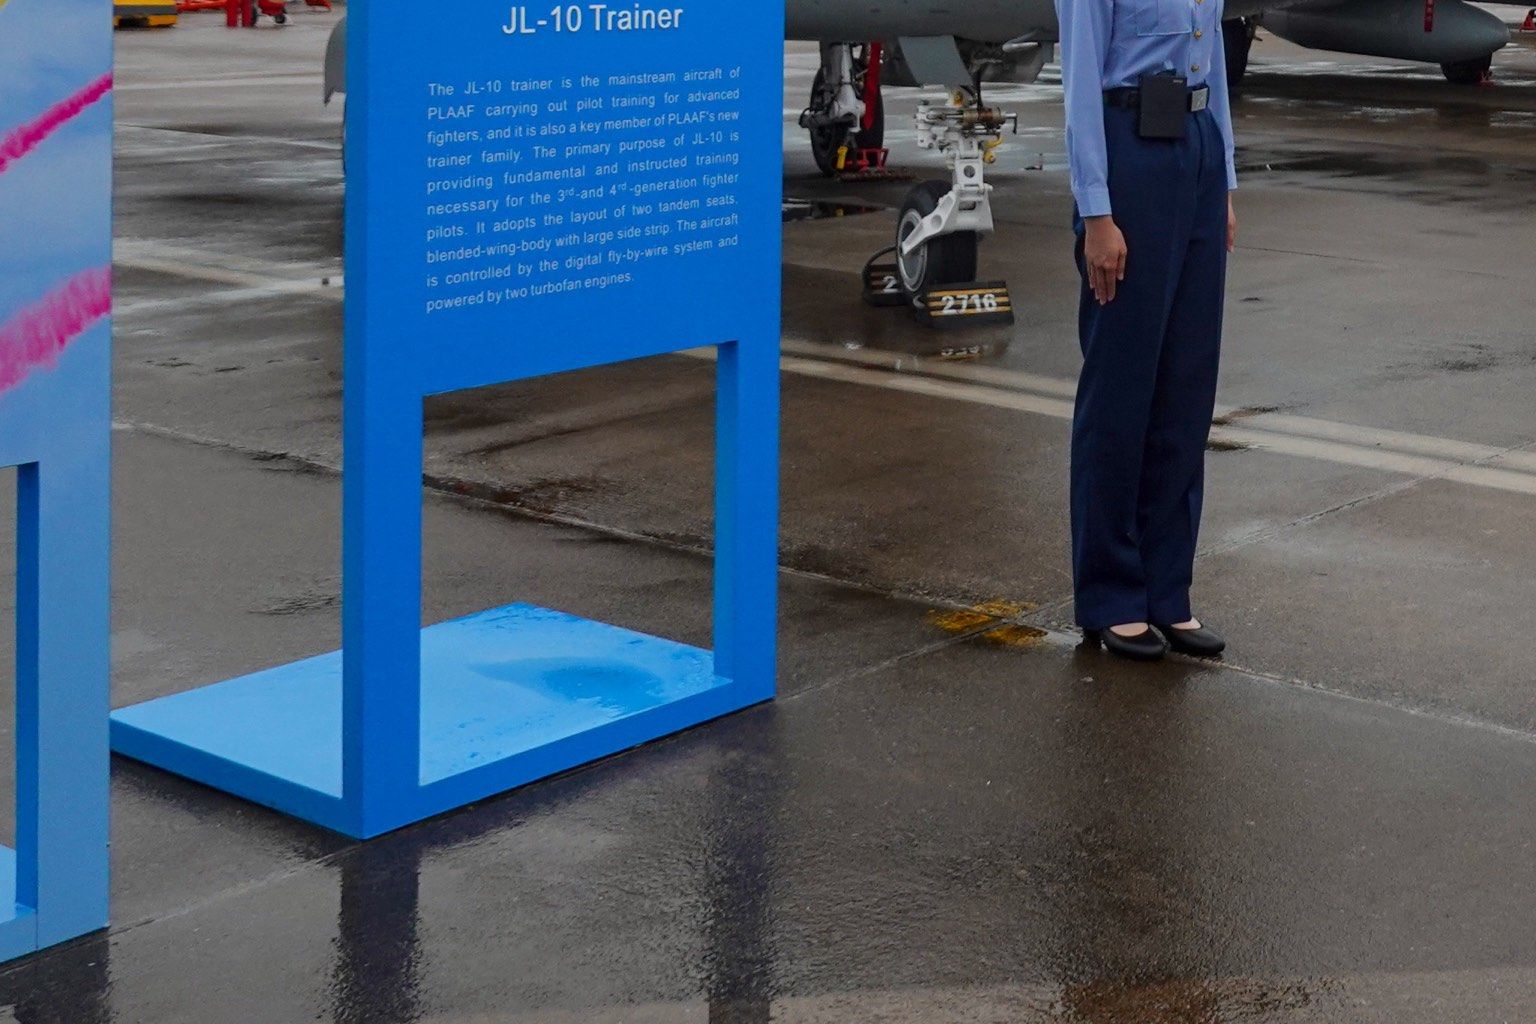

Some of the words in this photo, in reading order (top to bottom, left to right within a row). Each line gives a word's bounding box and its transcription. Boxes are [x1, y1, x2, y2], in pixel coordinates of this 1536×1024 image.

[502, 5, 582, 34] JL-10
[588, 3, 684, 31] Trainer
[428, 83, 454, 95] The
[464, 80, 501, 94] JL-10
[511, 80, 552, 91] trainer
[562, 79, 572, 88] is
[581, 75, 599, 87] the
[608, 73, 675, 85] mainstream
[683, 68, 722, 81] aircraft
[730, 67, 740, 78] of
[428, 105, 474, 120] PLAAF
[486, 104, 537, 117] carrying
[548, 100, 567, 112] out
[577, 98, 602, 112] pilot
[612, 96, 655, 107] training
[664, 92, 679, 103] for
[688, 89, 739, 102] advanced
[487, 127, 511, 139] and
[515, 126, 522, 136] it
[526, 127, 536, 136] is
[540, 123, 566, 135] also
[569, 124, 576, 133] a
[580, 121, 601, 133] key
[604, 118, 651, 129] member
[654, 114, 665, 126] of
[718, 112, 739, 121] new
[427, 155, 471, 168] trainer
[533, 146, 556, 158] The
[565, 144, 610, 158] primary
[619, 139, 665, 153] purpose
[674, 134, 684, 146] of
[693, 131, 722, 144] JL-10
[730, 132, 739, 141] is
[427, 176, 493, 194] providing
[504, 166, 585, 184] fundamental
[596, 163, 617, 175] and
[628, 157, 687, 171] instructed
[696, 153, 739, 165] training
[427, 200, 498, 215] necessary
[506, 195, 523, 206] for
[531, 192, 551, 204] the
[703, 174, 738, 188] fighter
[427, 225, 467, 241] pilots.
[477, 222, 485, 233] It
[493, 217, 536, 232] adopts
[544, 214, 563, 225] the
[571, 209, 607, 224] layout
[614, 205, 625, 217] of
[632, 205, 652, 215] two
[659, 199, 699, 212] tandem
[427, 238, 551, 263] blended-wing-body
[555, 234, 580, 246] with
[584, 231, 613, 244] large
[617, 226, 641, 239] side
[677, 220, 697, 230] The
[701, 213, 738, 228] aircraft
[427, 277, 438, 287] is
[446, 265, 510, 284] controlled
[518, 263, 532, 276] by
[540, 260, 558, 271] the
[565, 253, 601, 270] digital
[608, 246, 668, 264] fly-by-wire
[674, 240, 712, 255] system
[718, 235, 738, 247] and
[427, 291, 484, 313] powered
[487, 290, 502, 304] by
[505, 288, 528, 299] two
[531, 279, 581, 295] turbofan
[584, 273, 635, 288] engines.
[941, 293, 998, 315] 2716
